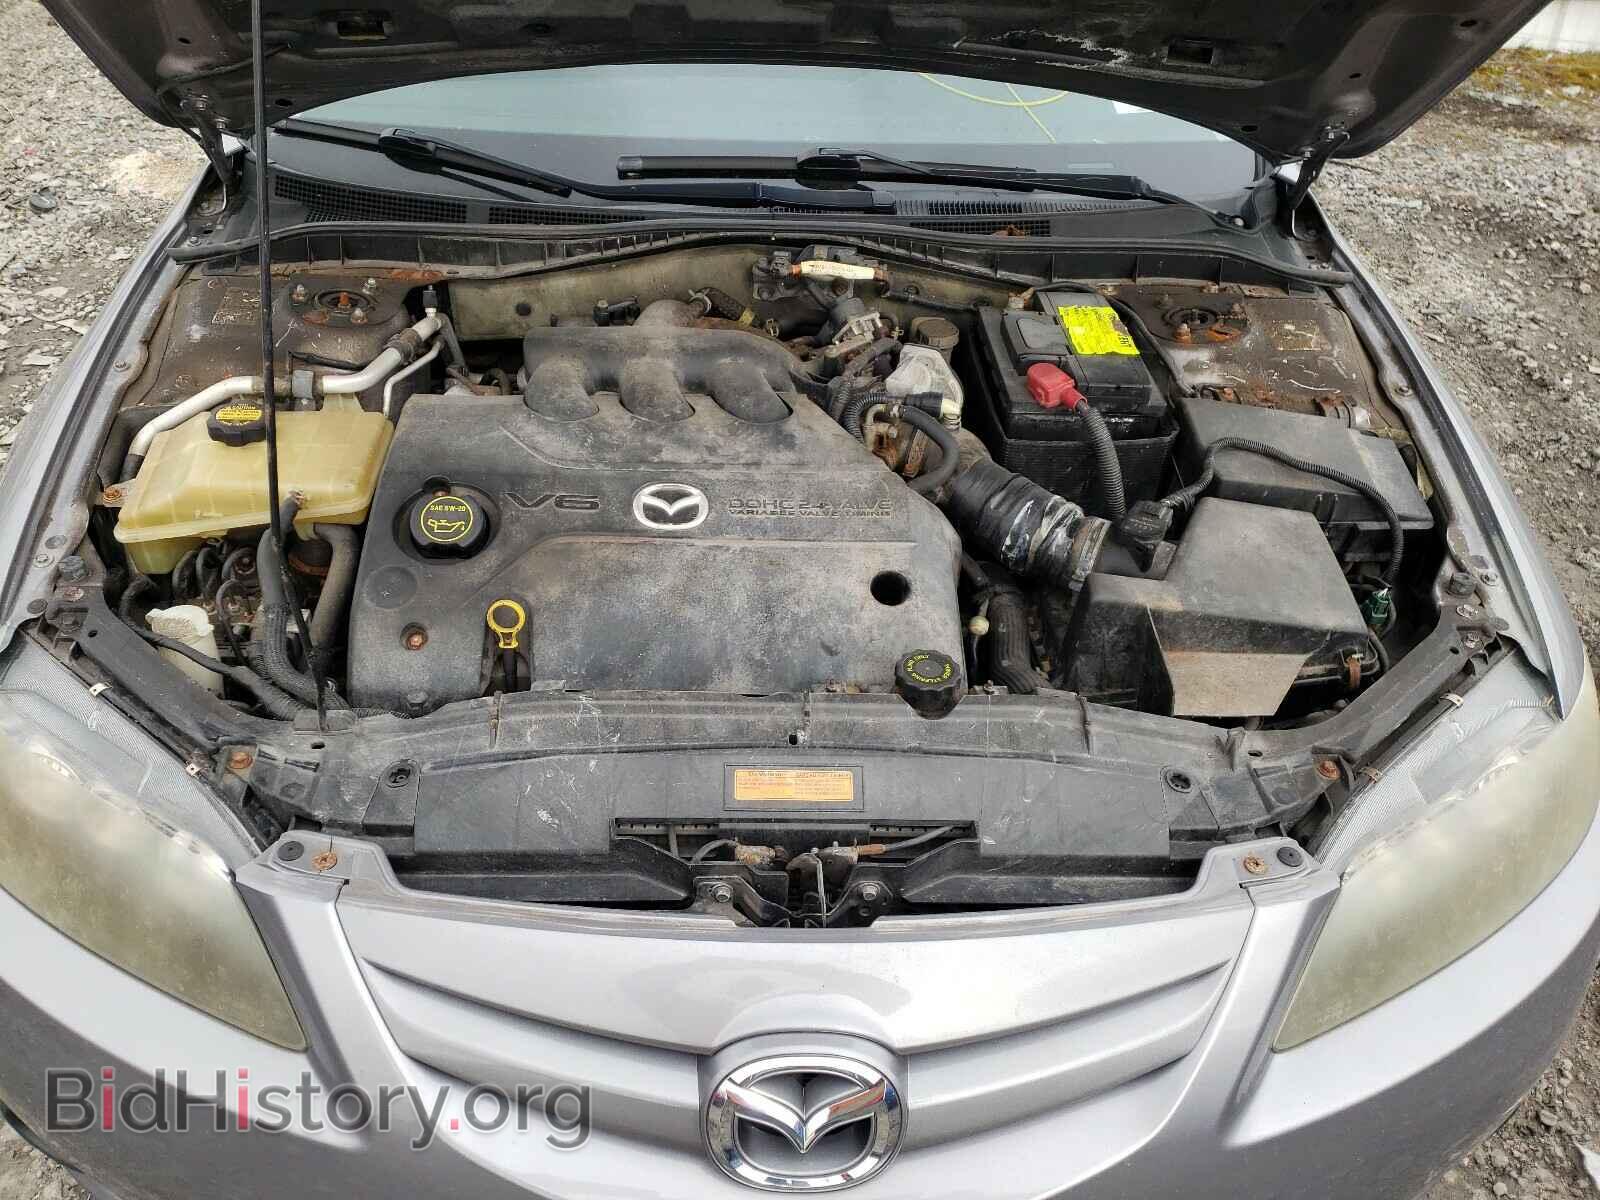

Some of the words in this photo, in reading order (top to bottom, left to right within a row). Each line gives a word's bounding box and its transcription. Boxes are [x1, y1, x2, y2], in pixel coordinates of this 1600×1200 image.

[502, 491, 600, 512] V6
[728, 498, 795, 510] DOHC
[429, 504, 442, 512] SAE
